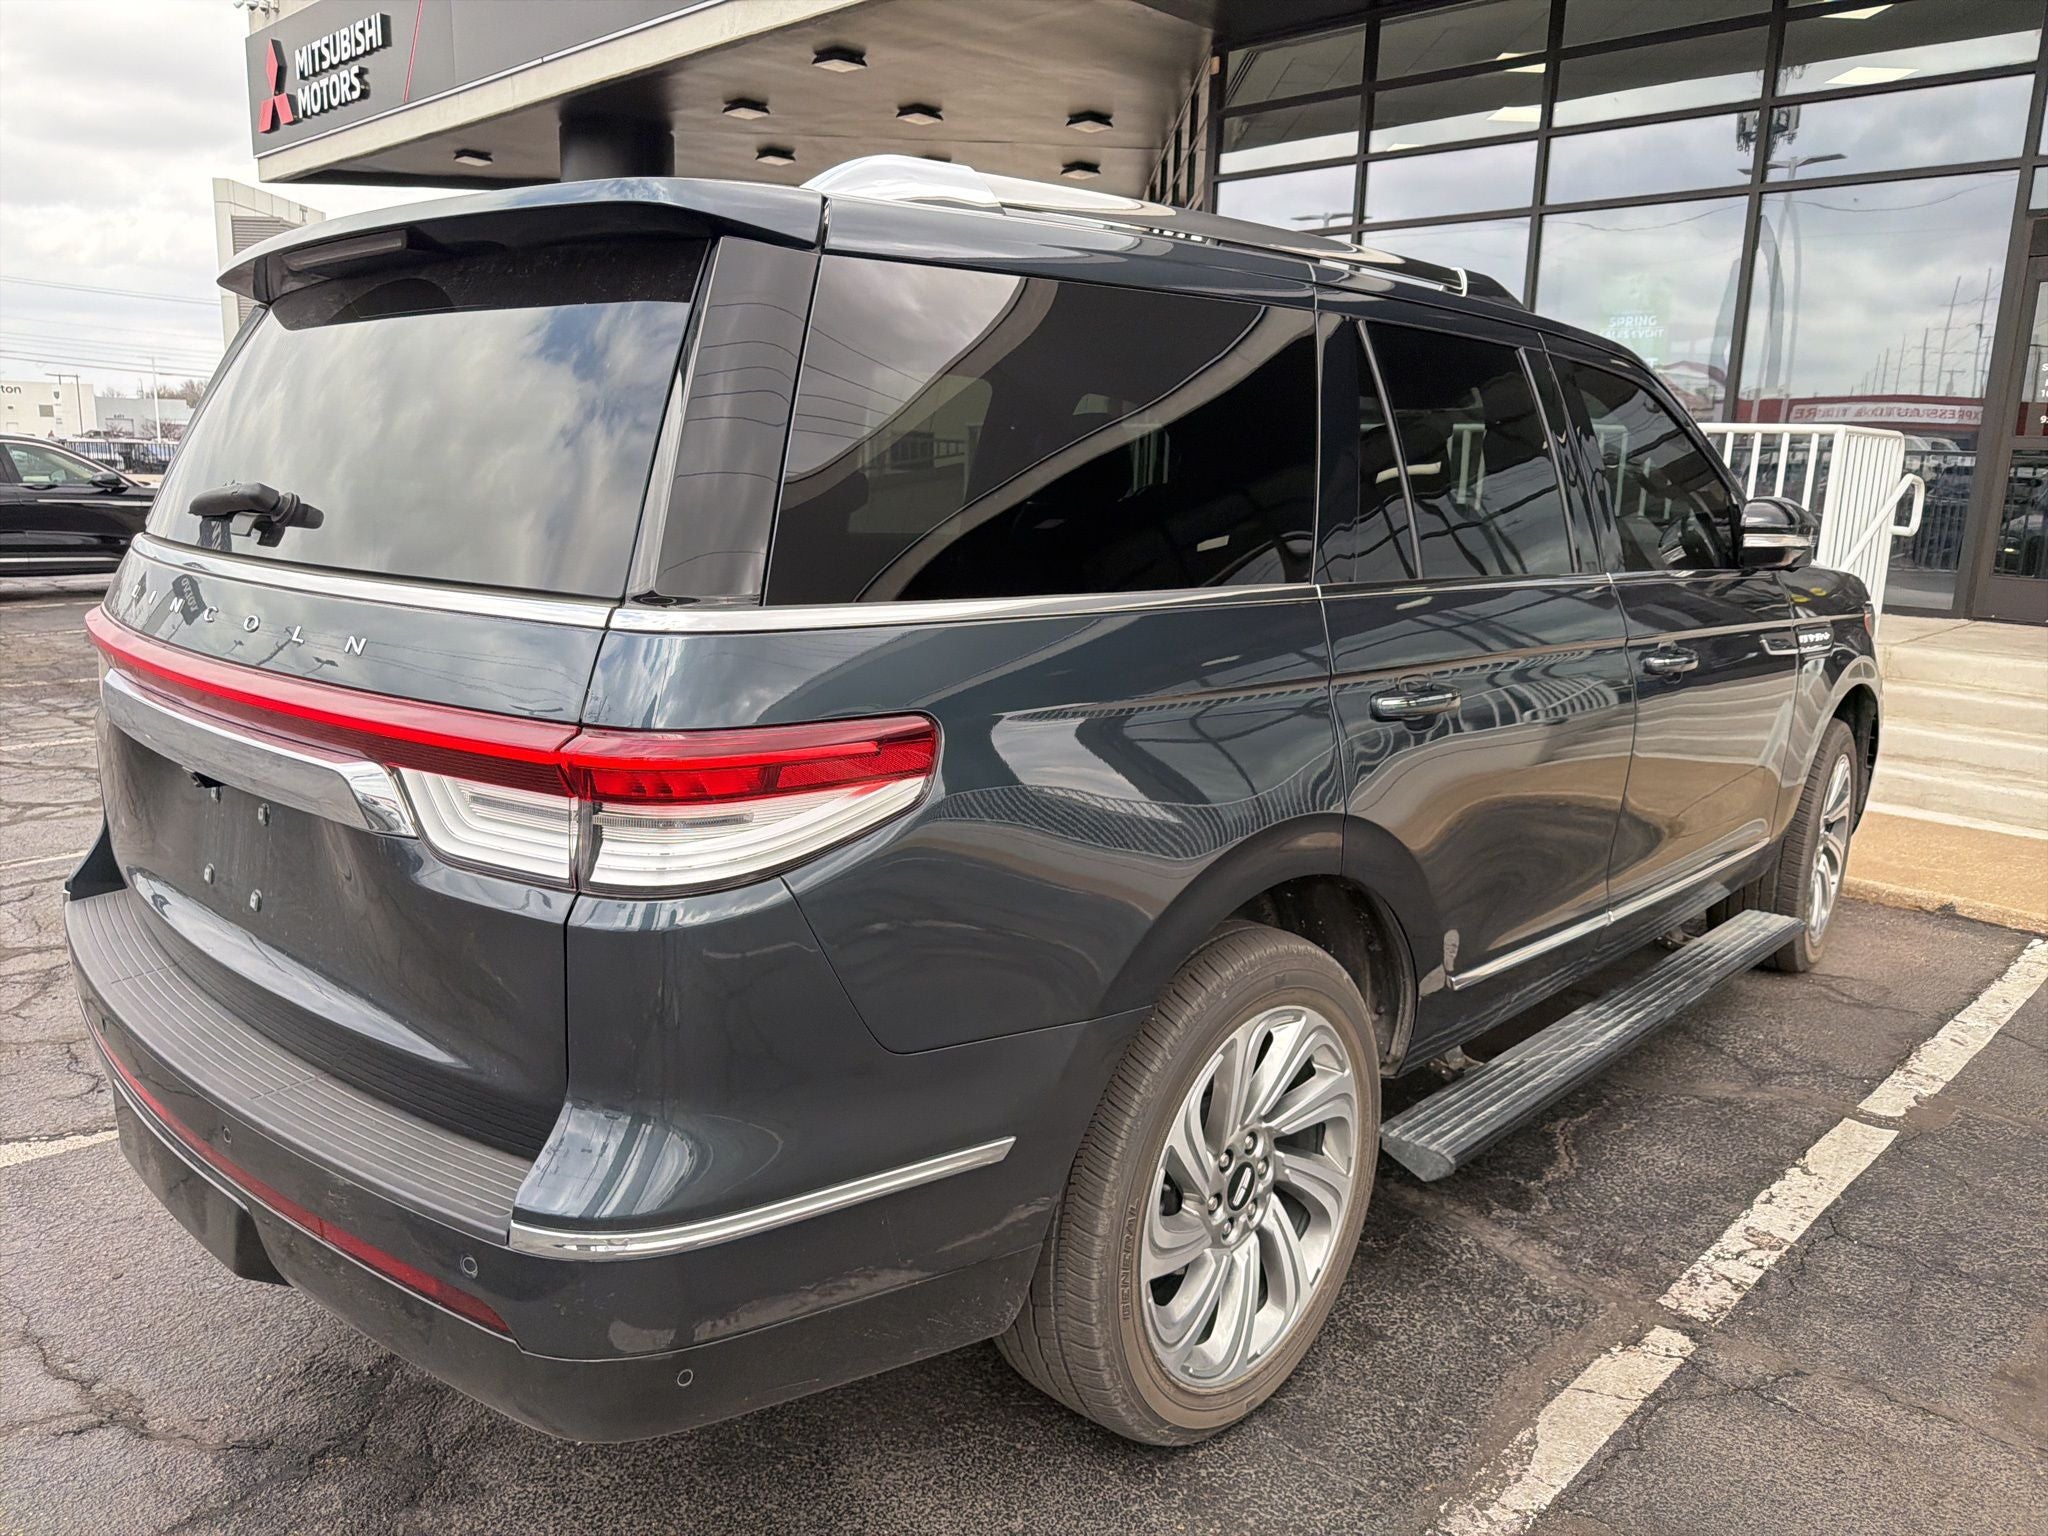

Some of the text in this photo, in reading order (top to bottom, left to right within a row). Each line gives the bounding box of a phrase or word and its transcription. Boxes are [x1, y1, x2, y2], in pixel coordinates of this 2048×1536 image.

[294, 12, 384, 81] MITSUBISHI
[297, 65, 361, 119] MOTORS
[1608, 315, 1657, 328] SPRING
[0, 385, 22, 394] ton
[131, 584, 367, 656] LINCOLN
[1120, 1198, 1139, 1321] GENERAL
